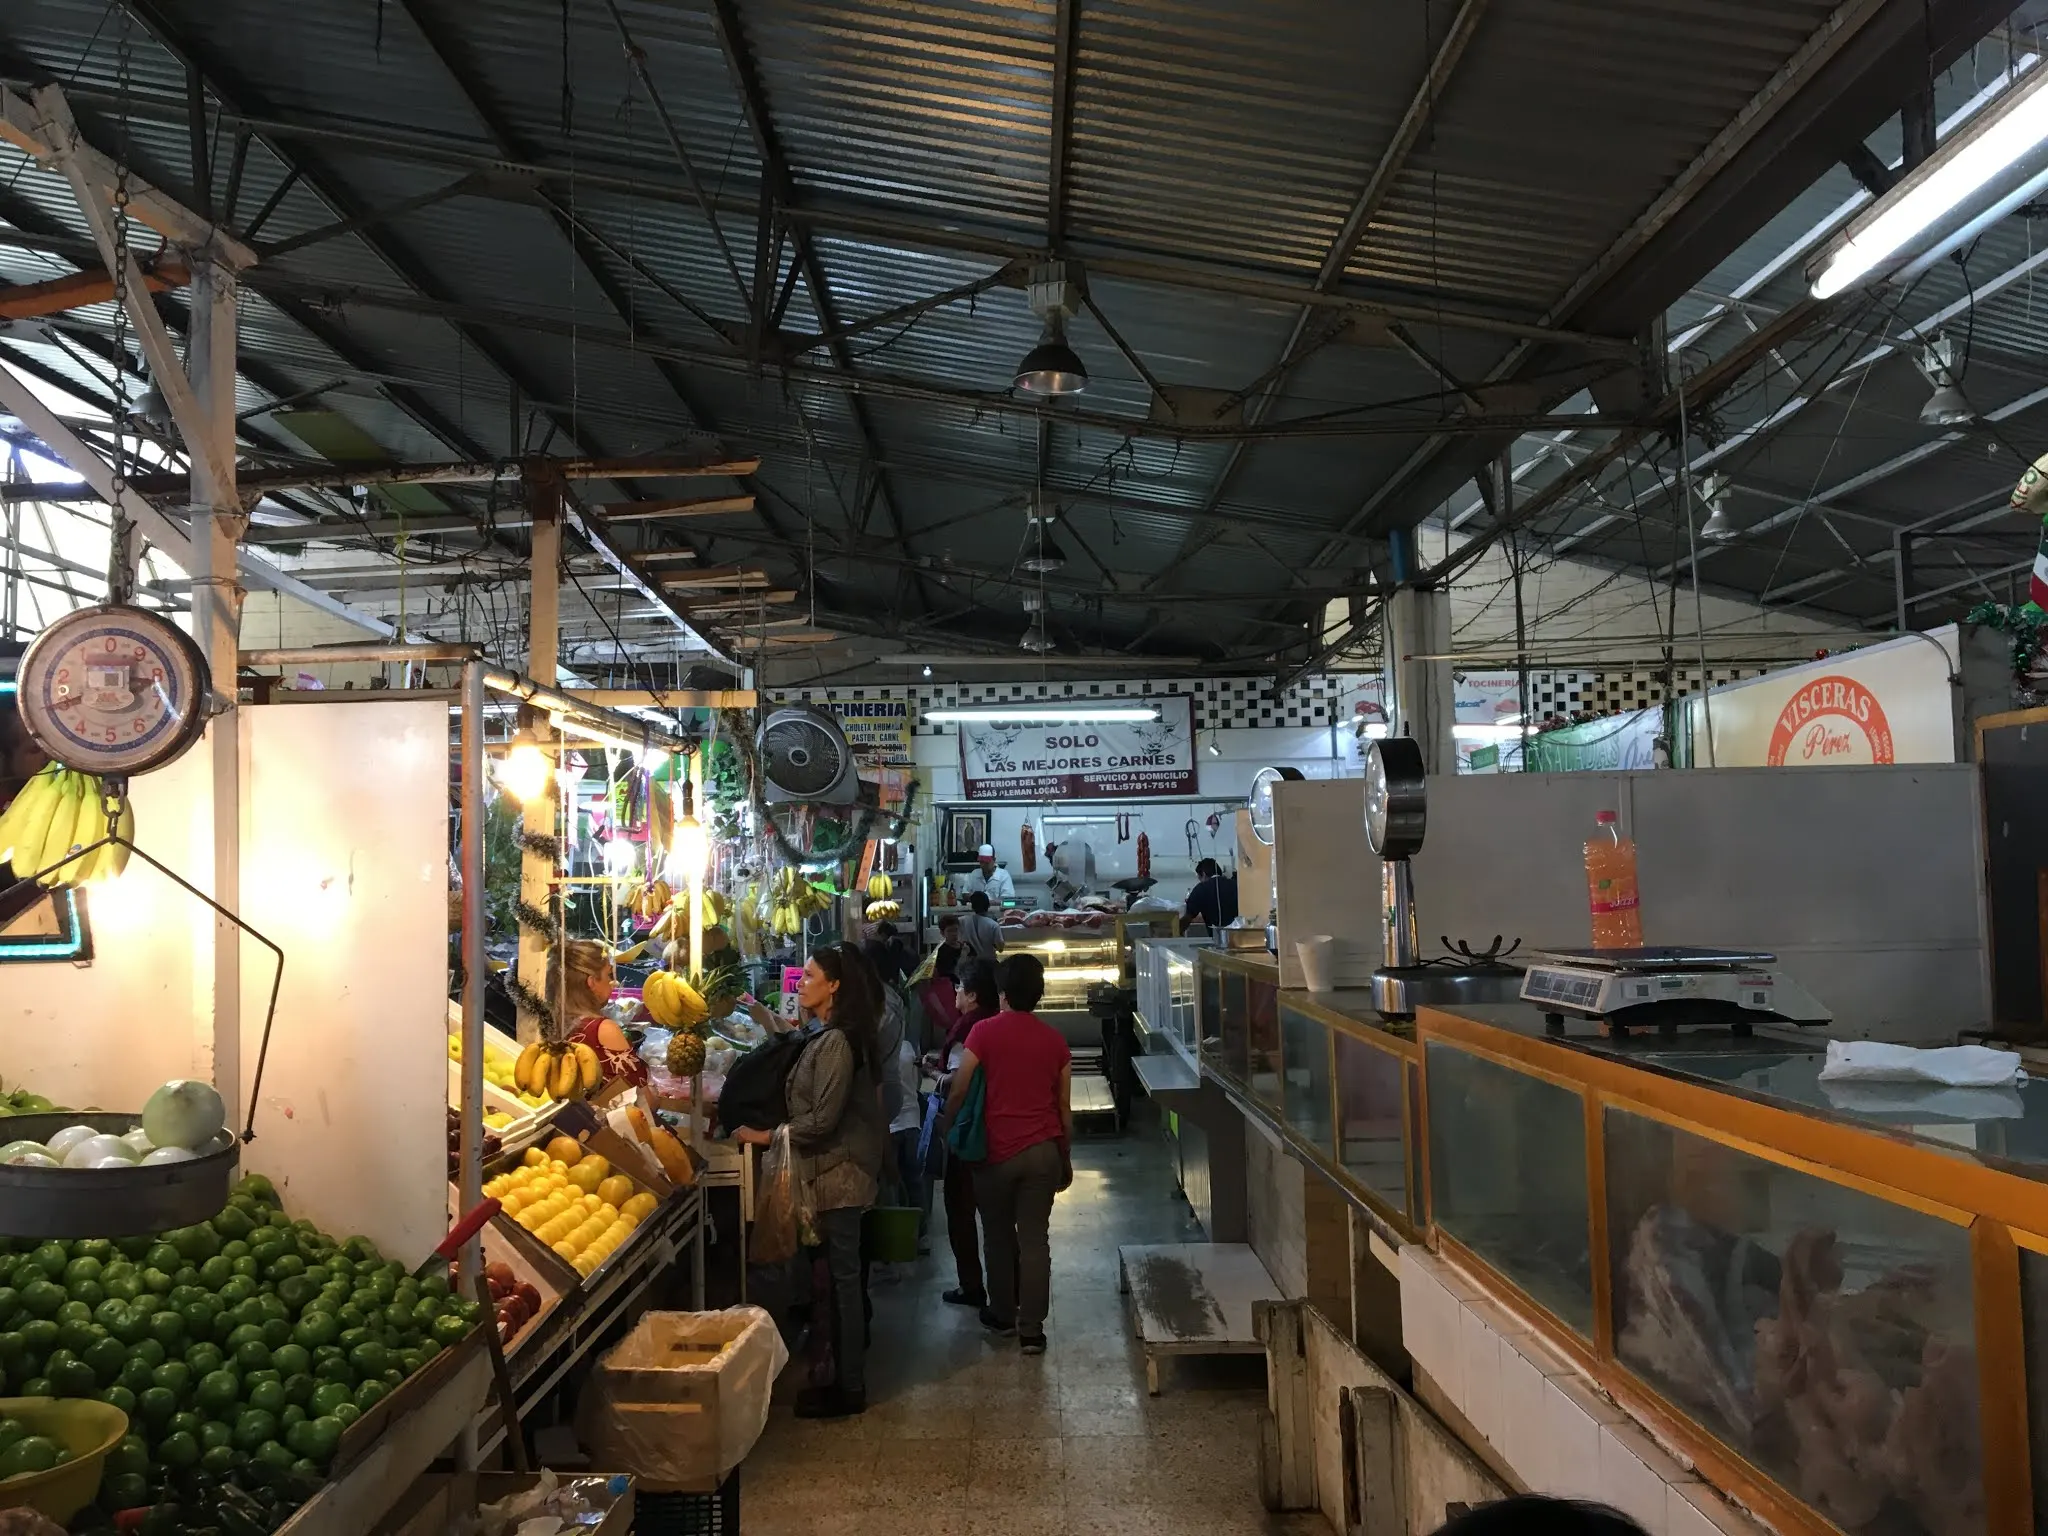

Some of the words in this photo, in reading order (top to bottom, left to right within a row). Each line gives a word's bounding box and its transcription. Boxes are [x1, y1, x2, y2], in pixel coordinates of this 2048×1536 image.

[105, 637, 117, 653] 0
[134, 646, 146, 662] 9
[813, 703, 907, 717] CINERIA
[1780, 682, 1871, 734] VISCERAS
[74, 720, 87, 735] 4
[133, 718, 146, 733] 6
[873, 722, 904, 731] AHUMA
[105, 728, 117, 743] 5
[1045, 734, 1099, 749] SOLO
[984, 761, 1016, 773] LAS
[1022, 757, 1101, 772] MEJORES
[1107, 754, 1176, 767] CARNES
[976, 779, 1017, 789] INTERIOR
[1019, 778, 1036, 786] DEL
[1083, 773, 1128, 782] SERVICIO
[1139, 771, 1188, 780] DOMICILIO
[972, 790, 997, 798] CASAS
[1034, 786, 1060, 795] LOCAL
[1061, 785, 1067, 794] 3
[1099, 781, 1177, 791] TEL:5781-7515
